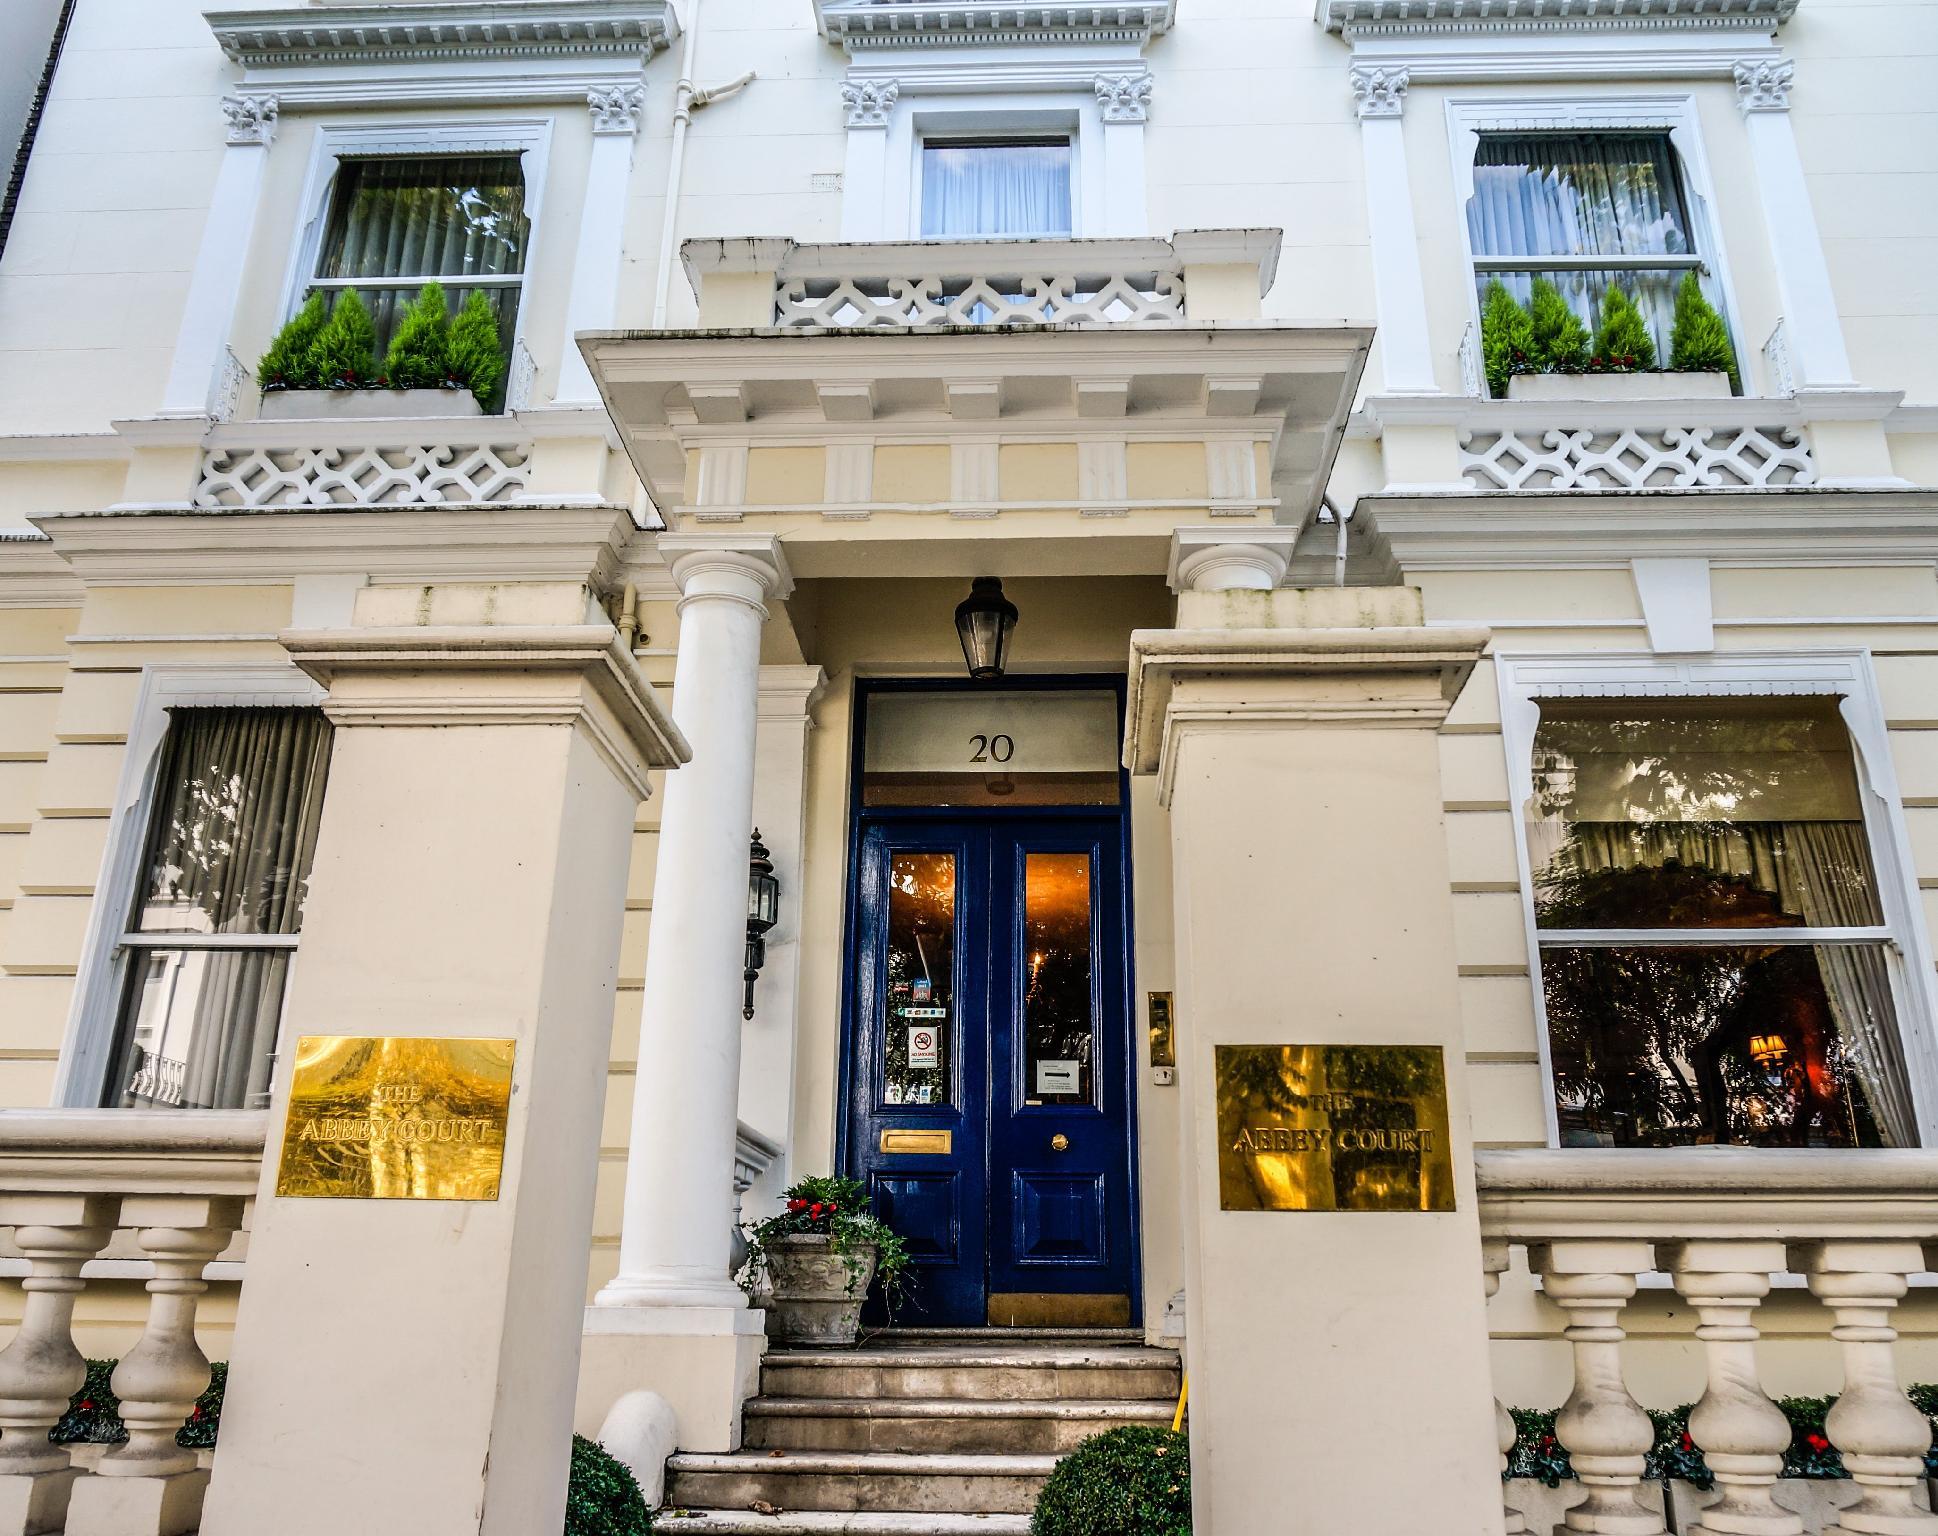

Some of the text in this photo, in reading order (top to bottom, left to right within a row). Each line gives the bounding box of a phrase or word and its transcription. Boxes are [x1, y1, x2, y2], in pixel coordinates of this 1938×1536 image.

[968, 734, 1015, 763] 20
[379, 1084, 422, 1102] THE
[1310, 1092, 1355, 1112] THE
[300, 1118, 493, 1142] ABBEY COURT
[1233, 1127, 1435, 1152] ABBEY COURT
